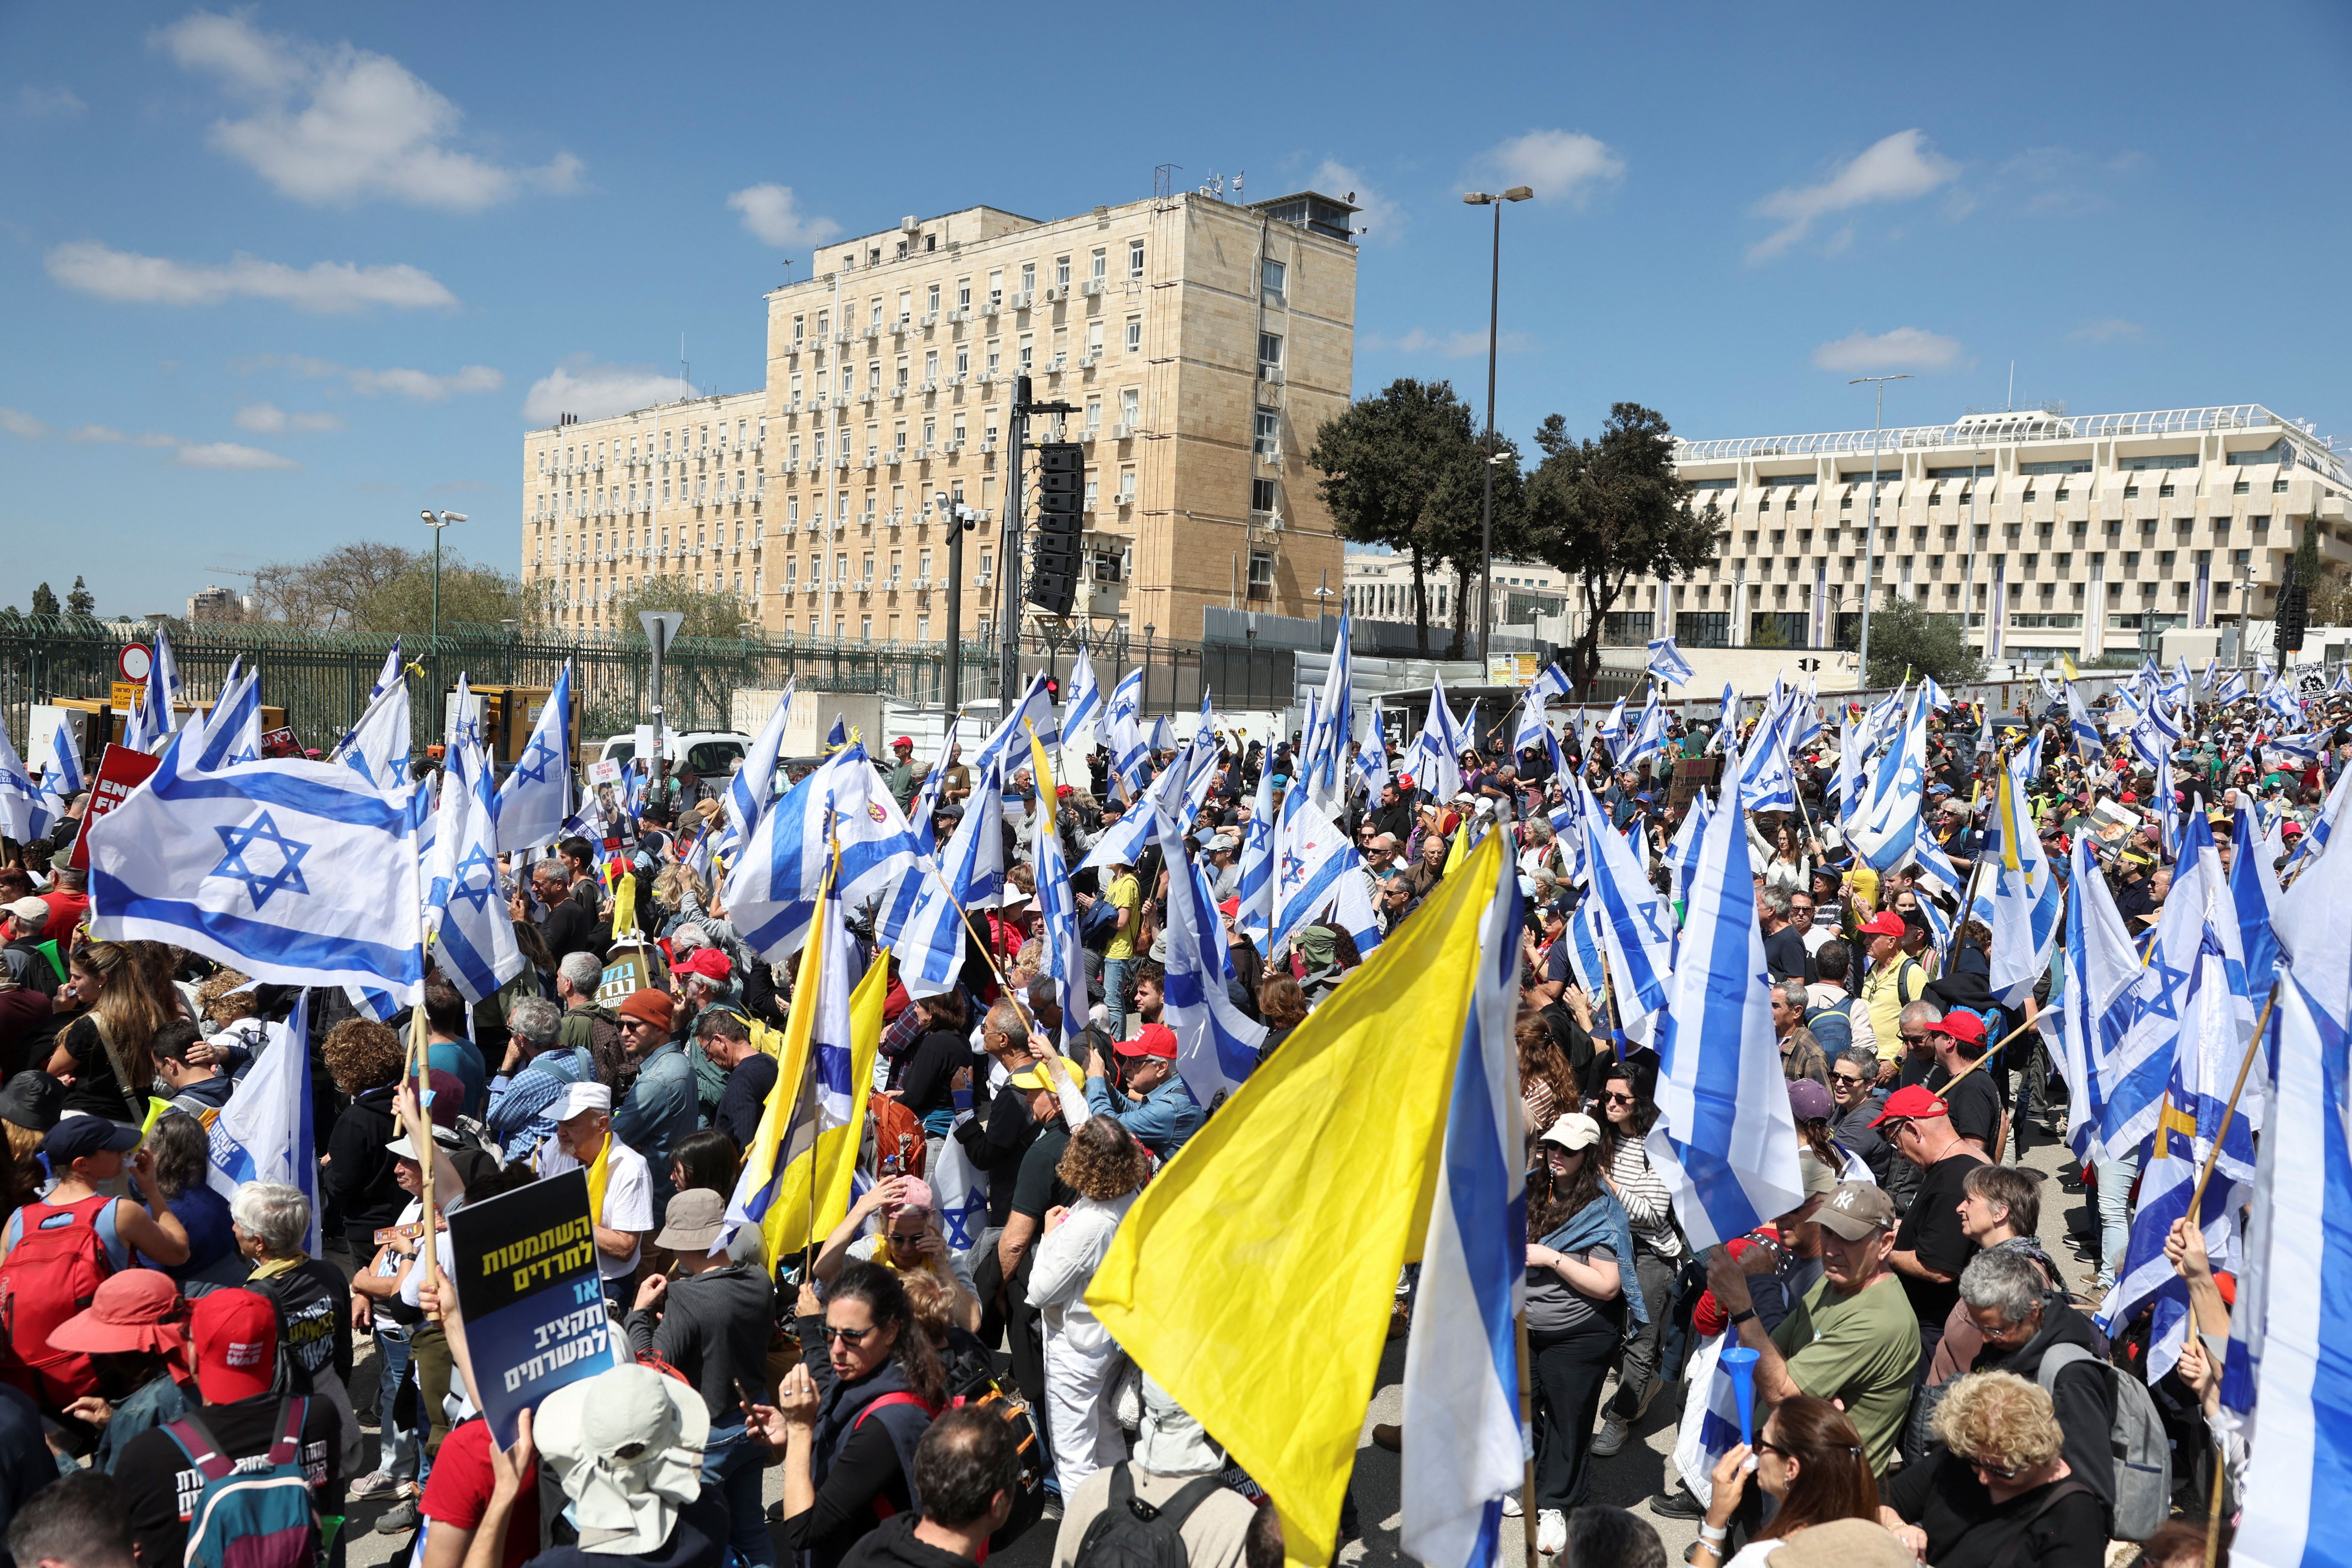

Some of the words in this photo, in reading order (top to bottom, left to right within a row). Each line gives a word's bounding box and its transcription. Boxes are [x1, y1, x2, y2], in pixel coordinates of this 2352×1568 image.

[272, 730, 291, 744] לא
[600, 978, 636, 997] נגד
[1832, 1190, 1854, 1210] NY
[482, 1215, 591, 1277] השתמטות
[513, 1241, 593, 1292] לחרדים
[573, 1277, 600, 1305] או
[533, 1303, 604, 1350] תקציב
[229, 1342, 247, 1350] END
[226, 1354, 260, 1366] WAR
[503, 1329, 607, 1393] למשרתים
